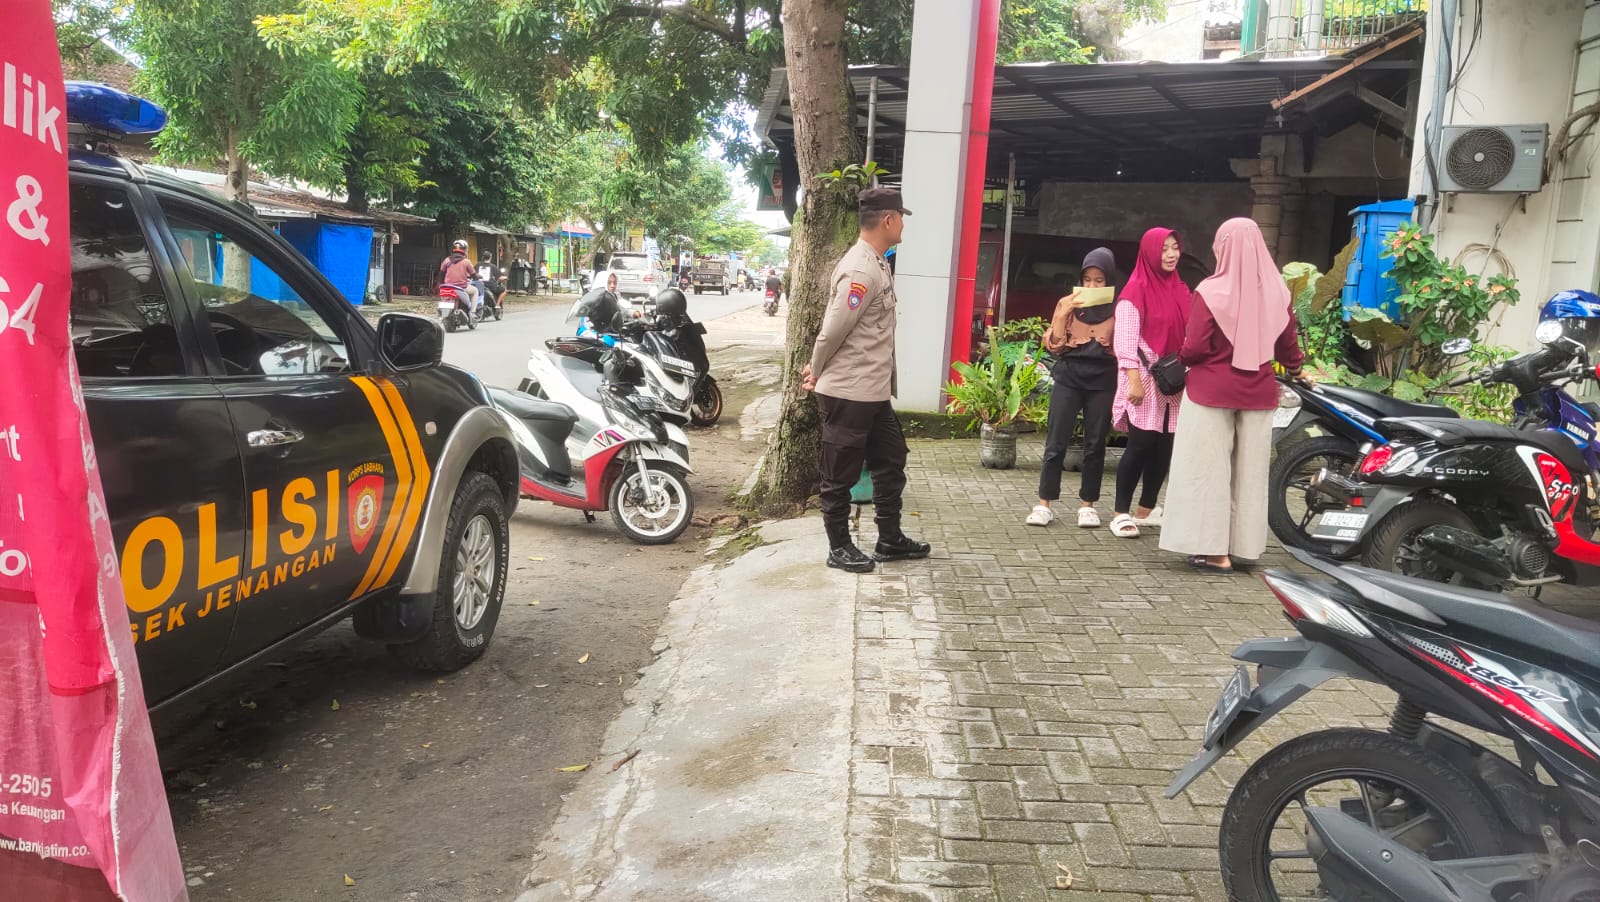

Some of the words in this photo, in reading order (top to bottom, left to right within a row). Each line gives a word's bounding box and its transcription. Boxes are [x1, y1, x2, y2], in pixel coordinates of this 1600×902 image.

[7, 174, 50, 247] &
[1566, 421, 1590, 440] YAMAHA
[1423, 467, 1489, 476] SCOOPY
[197, 542, 337, 618] JENANGAN
